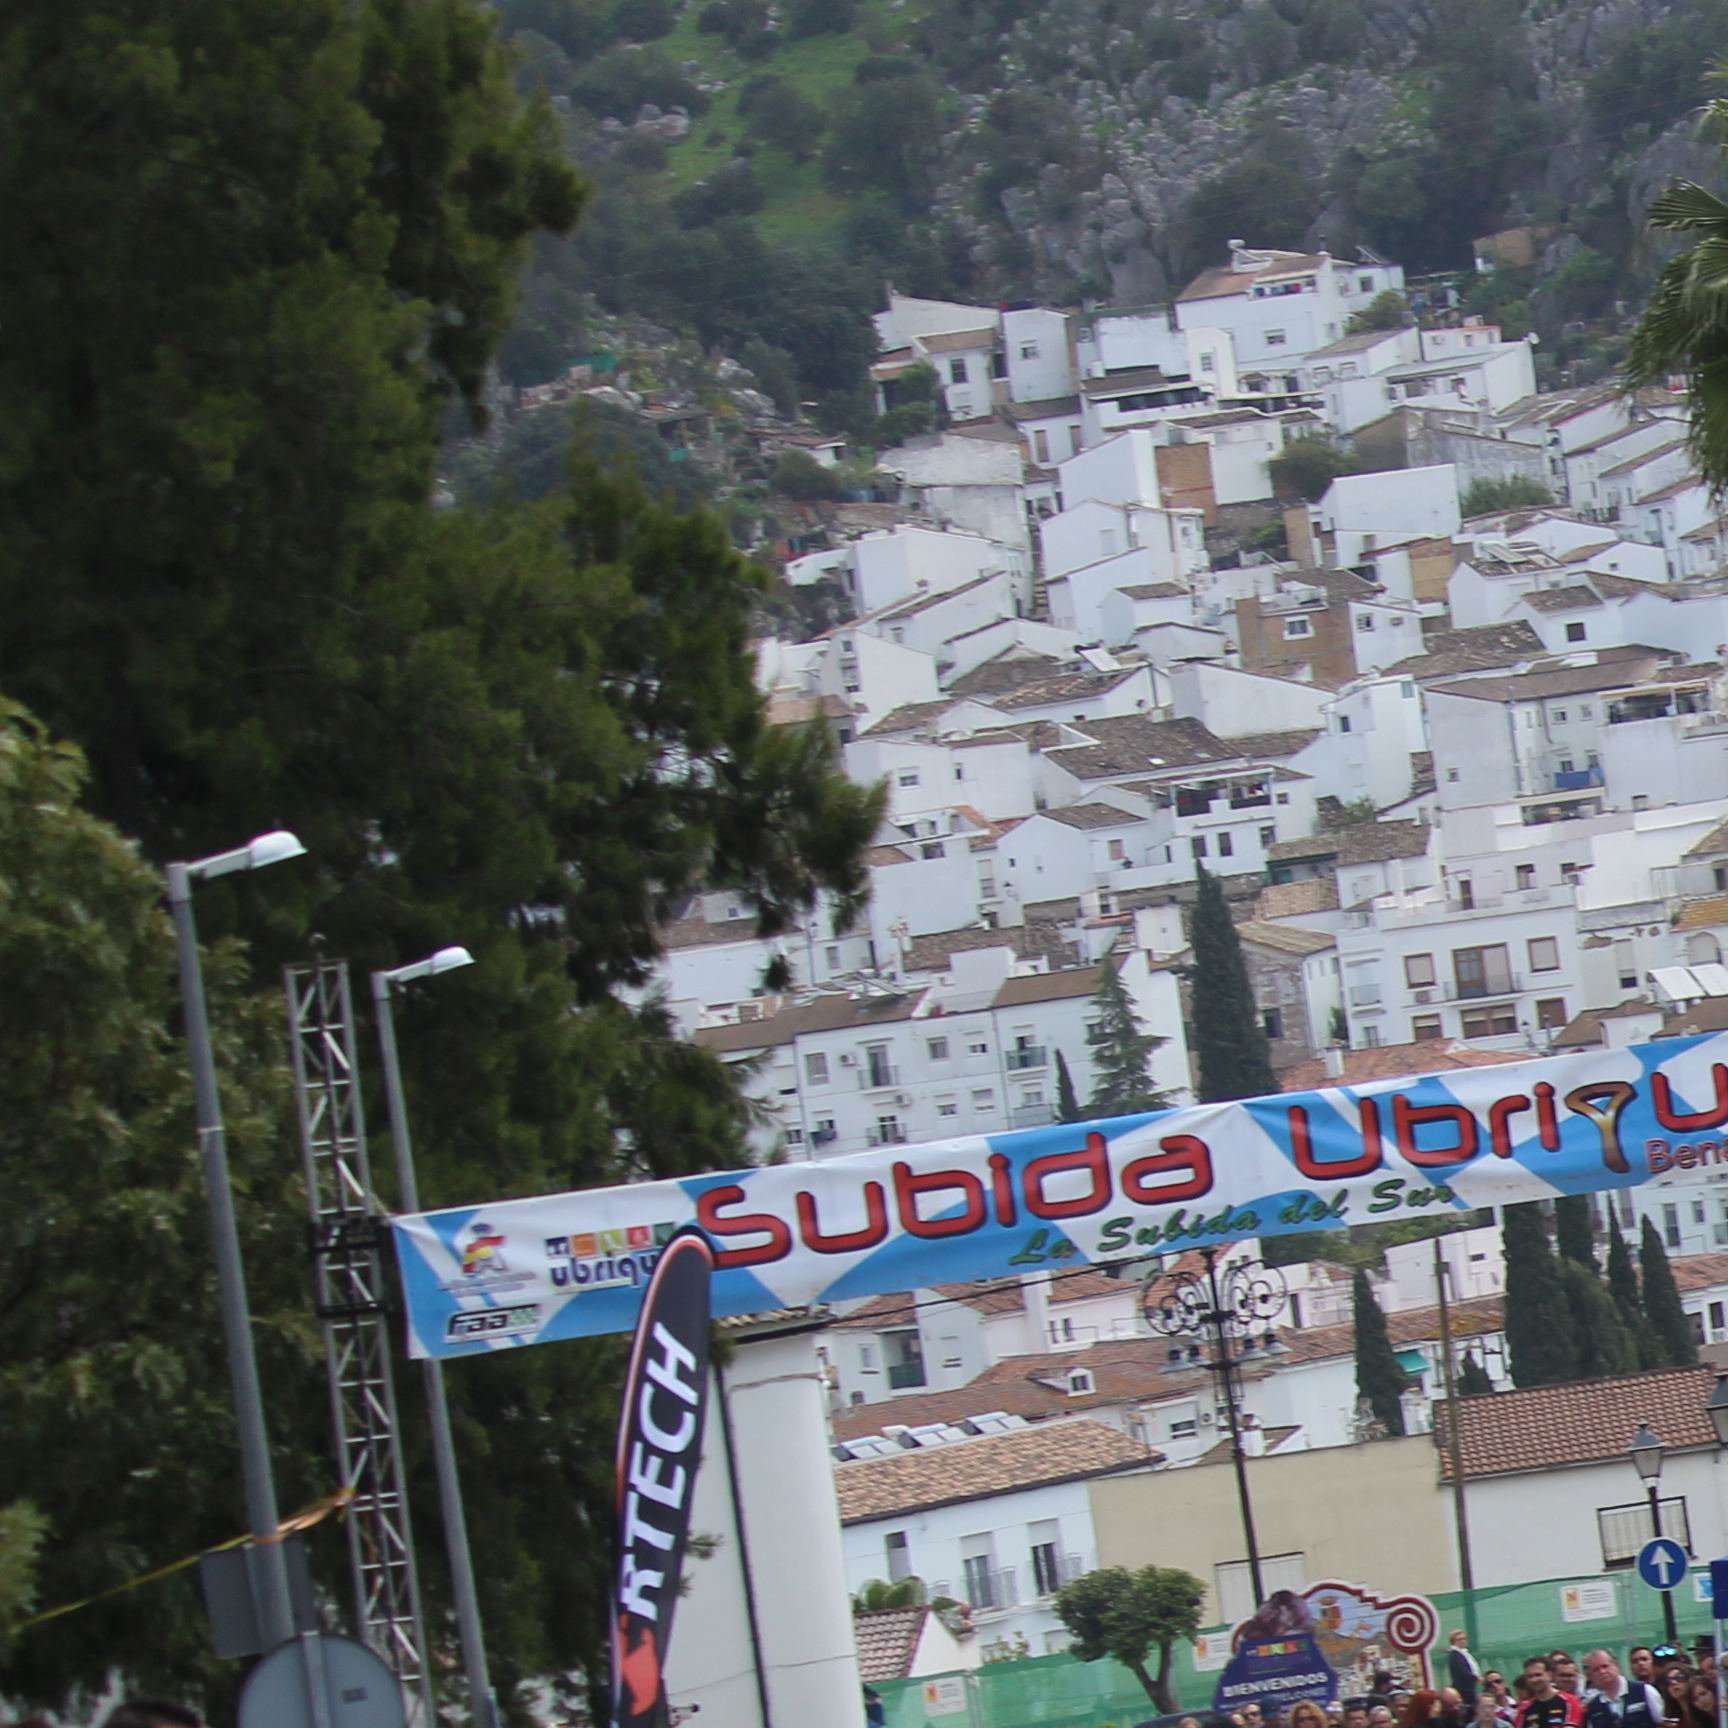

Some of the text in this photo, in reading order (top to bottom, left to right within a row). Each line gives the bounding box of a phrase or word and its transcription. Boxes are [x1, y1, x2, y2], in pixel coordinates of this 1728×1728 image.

[696, 1130, 1215, 1270] Subida
[1008, 1177, 1456, 1267] La Subida del Sur
[550, 1249, 662, 1288] ubriqu
[1222, 1671, 1329, 1698] BIENVENIDOS
